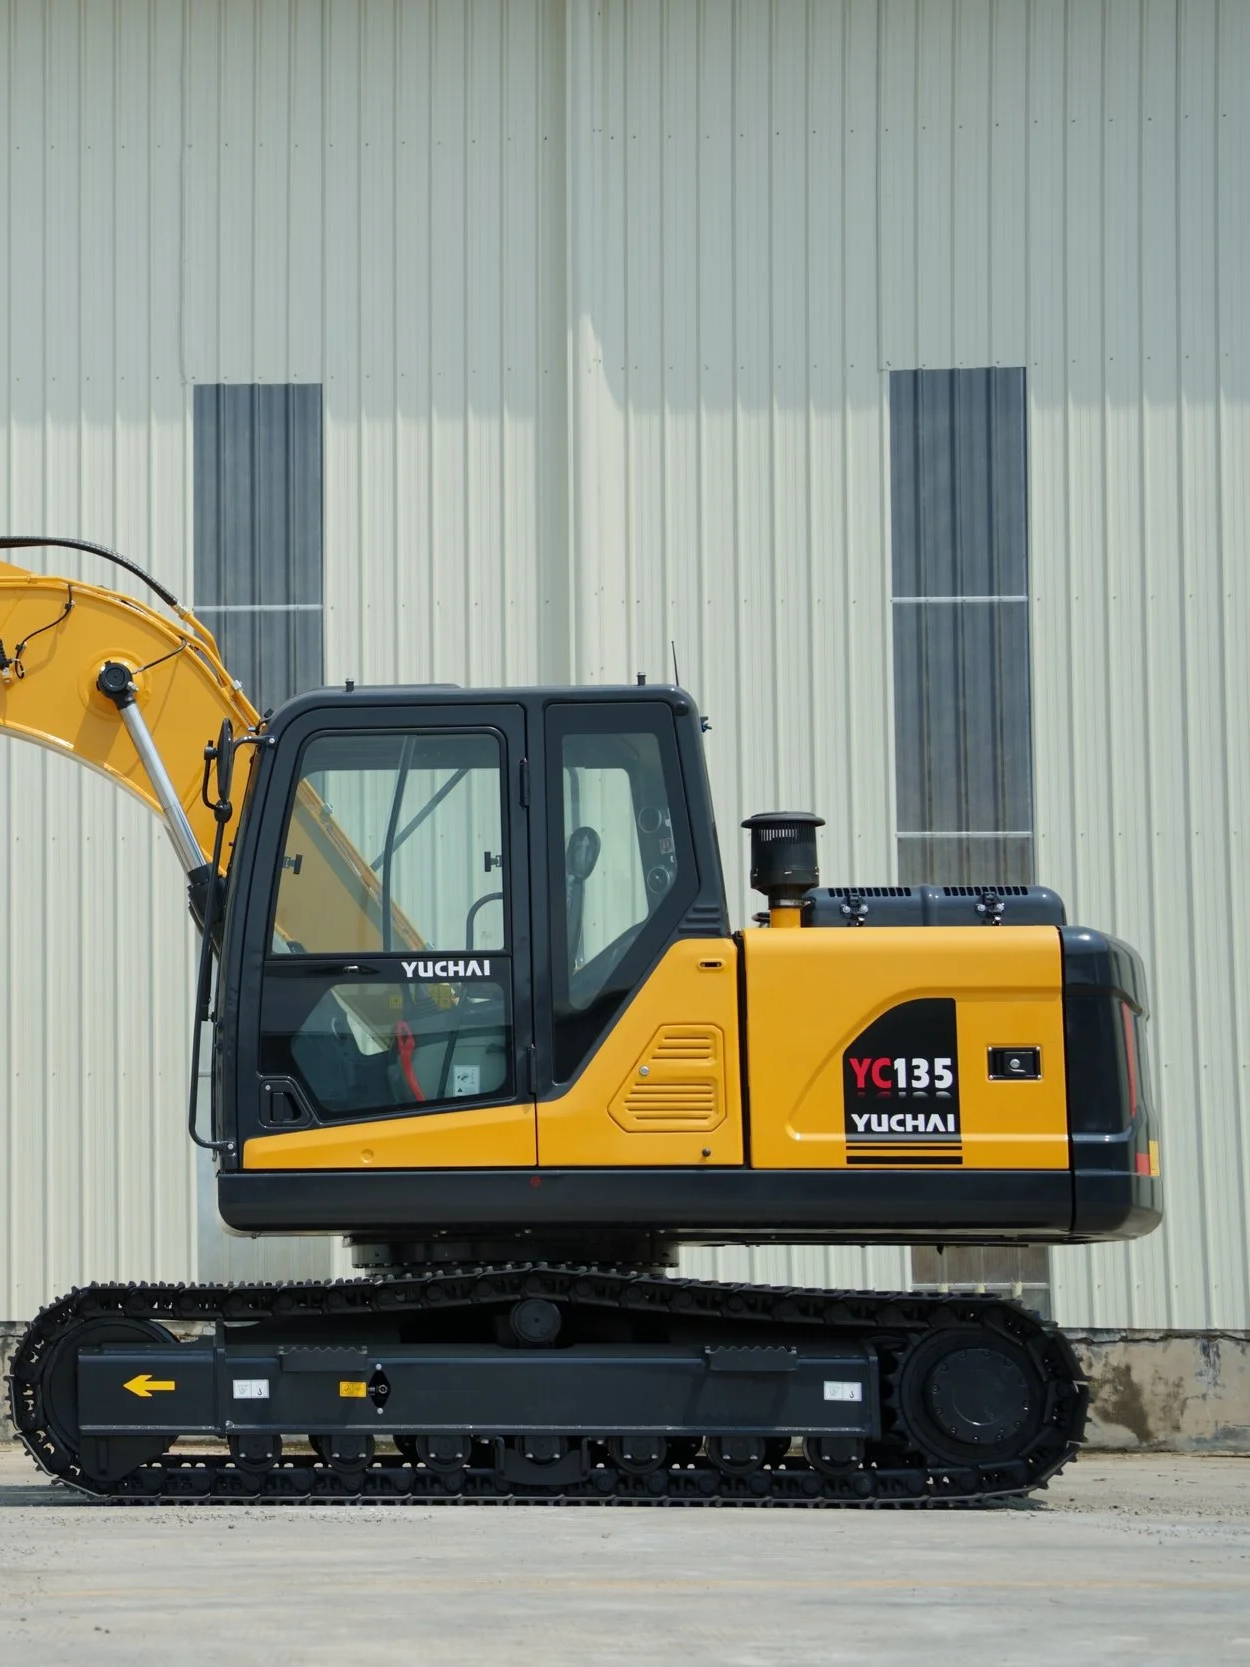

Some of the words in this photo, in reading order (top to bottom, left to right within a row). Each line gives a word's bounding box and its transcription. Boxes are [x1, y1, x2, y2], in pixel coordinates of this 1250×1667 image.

[402, 960, 490, 977] YUCHAI
[849, 1057, 954, 1088] YC135
[851, 1113, 955, 1132] YUCHAI
